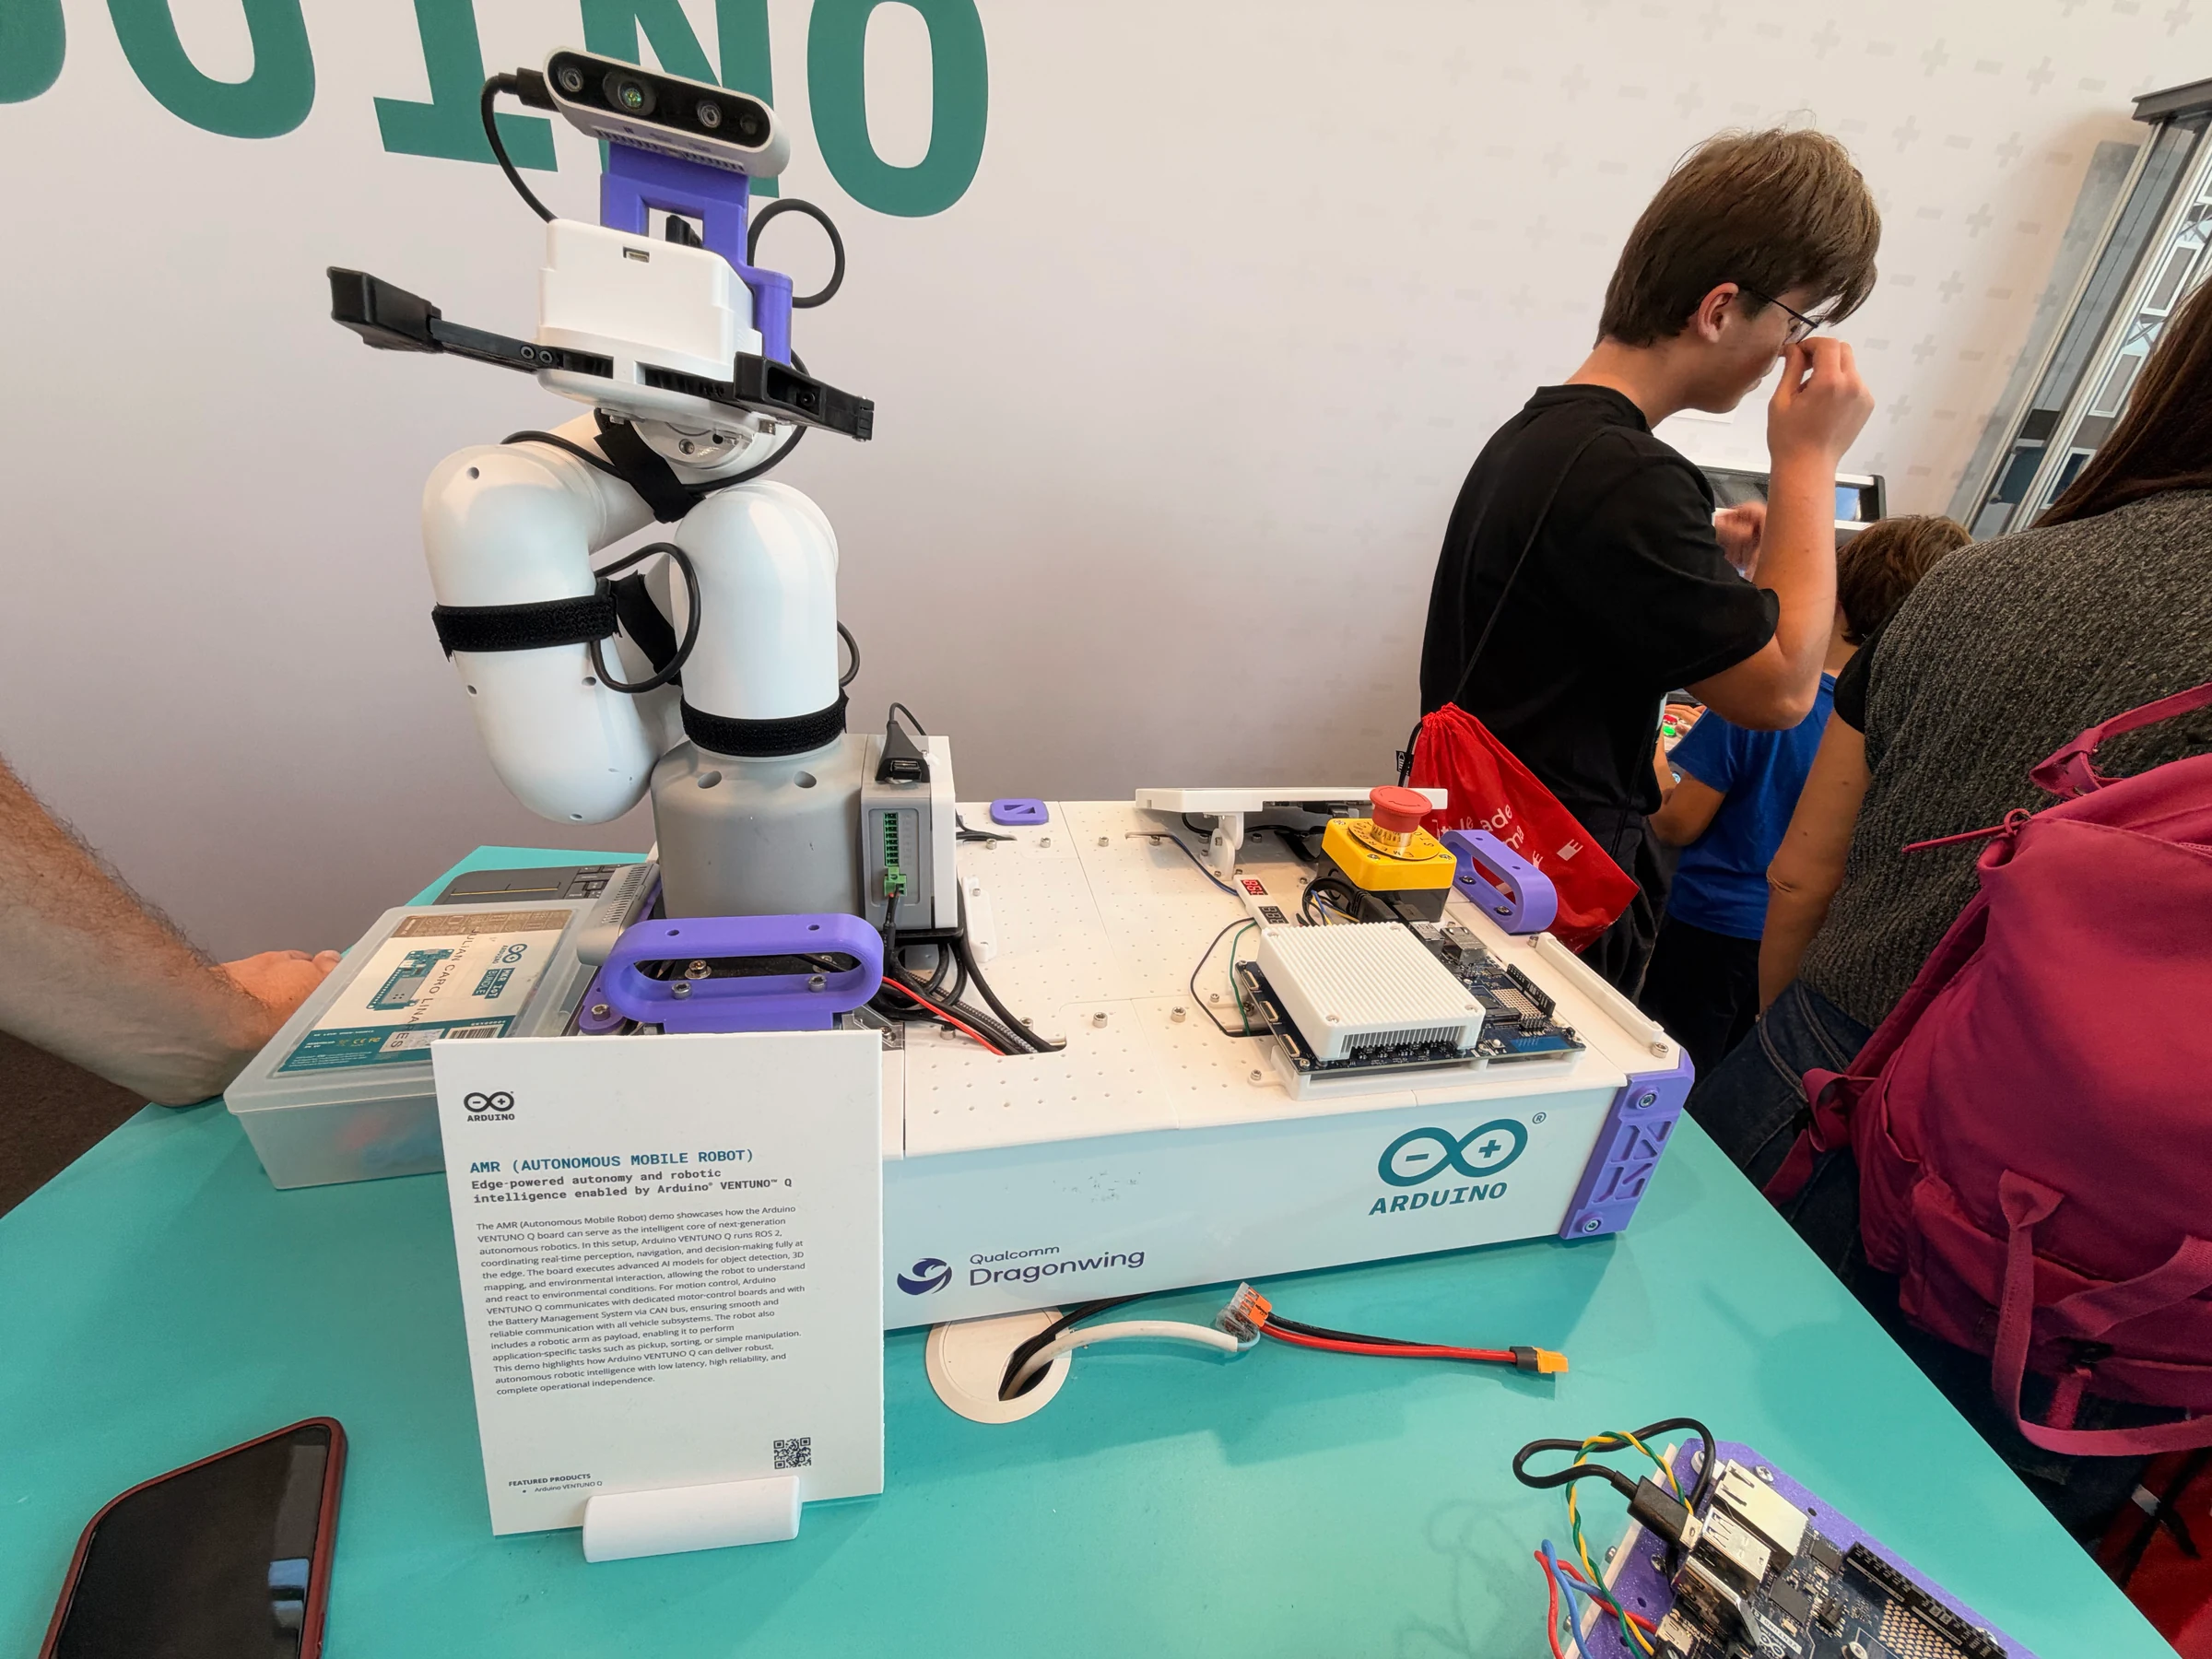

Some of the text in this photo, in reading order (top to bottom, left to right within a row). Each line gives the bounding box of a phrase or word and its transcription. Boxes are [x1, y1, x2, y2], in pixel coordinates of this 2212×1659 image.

[452, 929, 479, 961] JULIAN
[429, 964, 455, 994] CARO
[476, 970, 498, 994] BUNDLE
[466, 1112, 515, 1122] ARDUINO
[469, 1148, 753, 1174] AMR (AUTONOMOUS MOBILE ROBOT)
[471, 1168, 721, 1191] Edge-powered autonomy and robotic
[473, 1191, 567, 1204] intelligence
[573, 1185, 628, 1198] enabled
[634, 1185, 650, 1196] by
[783, 1178, 792, 1187] Q
[1369, 1182, 1508, 1216] ARDUINO
[476, 1222, 494, 1230] The
[495, 1220, 518, 1230] AMR
[519, 1218, 582, 1230] (Autonomous
[583, 1216, 615, 1224] Mobile
[617, 1214, 647, 1222] Robot)
[676, 1210, 724, 1219] showcases
[761, 1206, 795, 1214] Arduino
[477, 1232, 525, 1242] VENTUNO
[526, 1232, 535, 1241] Q
[536, 1230, 565, 1240] board
[584, 1229, 609, 1237] serve
[623, 1226, 639, 1234] the
[641, 1224, 684, 1233] intelligent
[707, 1220, 716, 1230] of
[718, 1218, 785, 1229] next-generation
[478, 1245, 538, 1255] autonomous
[540, 1242, 580, 1252] robotics.
[593, 1240, 609, 1248] this
[641, 1236, 677, 1245] Arduino
[677, 1232, 723, 1242] VENTUNO
[724, 1232, 732, 1241] Q
[754, 1230, 772, 1238] ROS
[480, 1256, 539, 1267] coordinating
[540, 1254, 582, 1264] real-time
[583, 1251, 634, 1263] perception,
[636, 1247, 684, 1258] navigation,
[686, 1245, 702, 1253] and
[704, 1241, 773, 1253] decision-making
[775, 1240, 793, 1249] fully
[970, 1246, 1060, 1265] Qualcomm
[482, 1271, 498, 1279] the
[500, 1269, 525, 1279] edge.
[525, 1268, 545, 1277] The
[546, 1265, 573, 1276] board
[575, 1265, 615, 1273] executes
[617, 1260, 659, 1271] advanced
[672, 1257, 704, 1266] models
[705, 1256, 719, 1265] for
[720, 1255, 747, 1265] object
[747, 1253, 790, 1262] detection,
[792, 1251, 804, 1259] 3D
[483, 1282, 526, 1292] mapping,
[528, 1279, 547, 1288] and
[547, 1275, 614, 1287] environmental
[615, 1272, 665, 1282] interaction,
[666, 1269, 703, 1278] allowing
[721, 1266, 745, 1275] robot
[757, 1262, 806, 1273] understand
[971, 1251, 1145, 1286] Dragonwing
[485, 1294, 503, 1303] and
[541, 1288, 607, 1300] environmental
[608, 1285, 656, 1294] conditions.
[675, 1281, 706, 1289] motion
[707, 1277, 740, 1288] control,
[742, 1276, 776, 1285] Arduino
[486, 1304, 533, 1315] VENTUNO
[534, 1304, 543, 1312] Q
[544, 1300, 609, 1311] communicates
[611, 1297, 630, 1306] with
[631, 1294, 676, 1304] dedicated
[677, 1289, 736, 1301] motor-control
[737, 1287, 768, 1297] boards
[769, 1286, 785, 1294] and
[504, 1317, 538, 1325] Battery
[539, 1312, 599, 1323] Management
[600, 1310, 632, 1320] System
[633, 1308, 647, 1316] via
[649, 1306, 668, 1314] CAN
[669, 1305, 688, 1313] bus,
[689, 1302, 727, 1312] ensuring
[728, 1300, 761, 1309] smooth
[762, 1298, 779, 1306] and
[489, 1328, 524, 1338] reliable
[524, 1324, 594, 1335] communication
[595, 1322, 615, 1330] with
[617, 1320, 628, 1328] all
[628, 1318, 659, 1327] vehicle
[660, 1315, 713, 1325] subsystems.
[492, 1347, 577, 1362] application-specific
[578, 1346, 602, 1354] tasks
[603, 1344, 624, 1352] such
[637, 1341, 668, 1351] pickup,
[670, 1338, 702, 1347] sorting,
[714, 1335, 743, 1344] simple
[745, 1330, 801, 1341] manipulation.
[496, 1376, 654, 1395] complete operational independence.
[508, 1473, 591, 1487] FEATURED PRODUCTS
